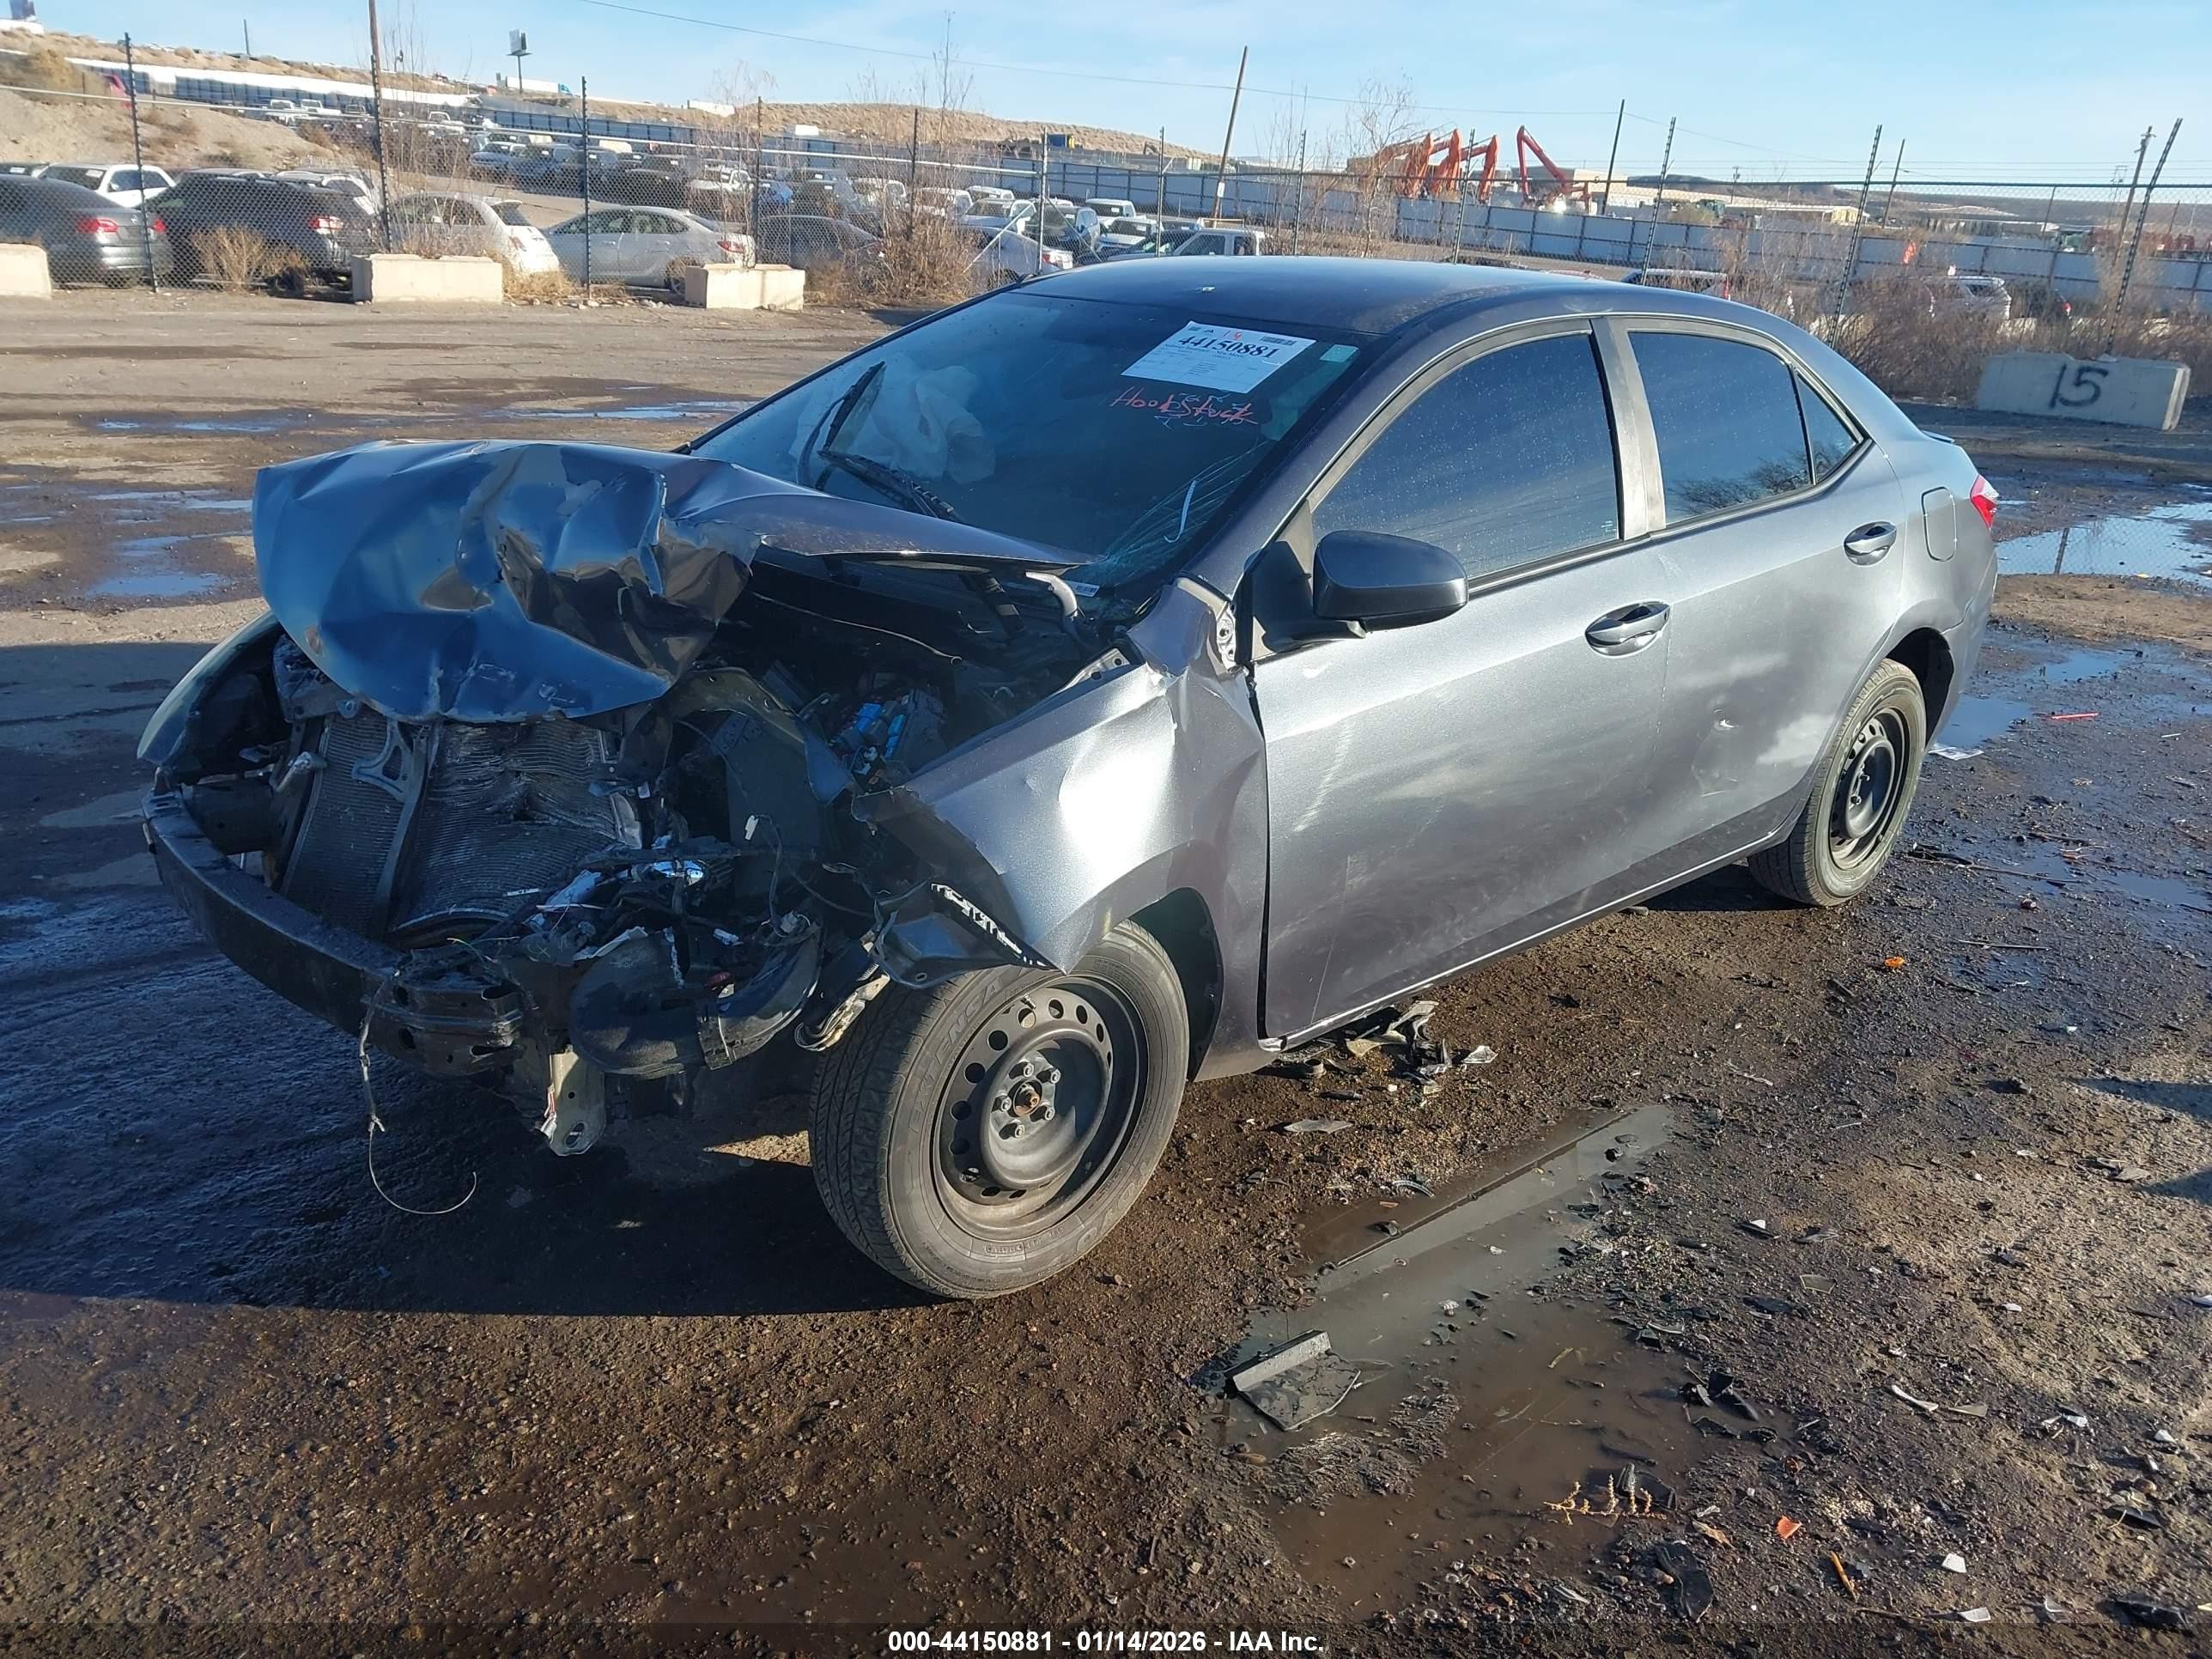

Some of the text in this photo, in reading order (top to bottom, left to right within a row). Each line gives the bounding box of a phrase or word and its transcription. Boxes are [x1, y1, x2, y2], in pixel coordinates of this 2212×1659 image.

[1178, 335, 1280, 358] 44150881
[2047, 362, 2110, 410] 15
[908, 978, 1004, 1133] EXTENSA
